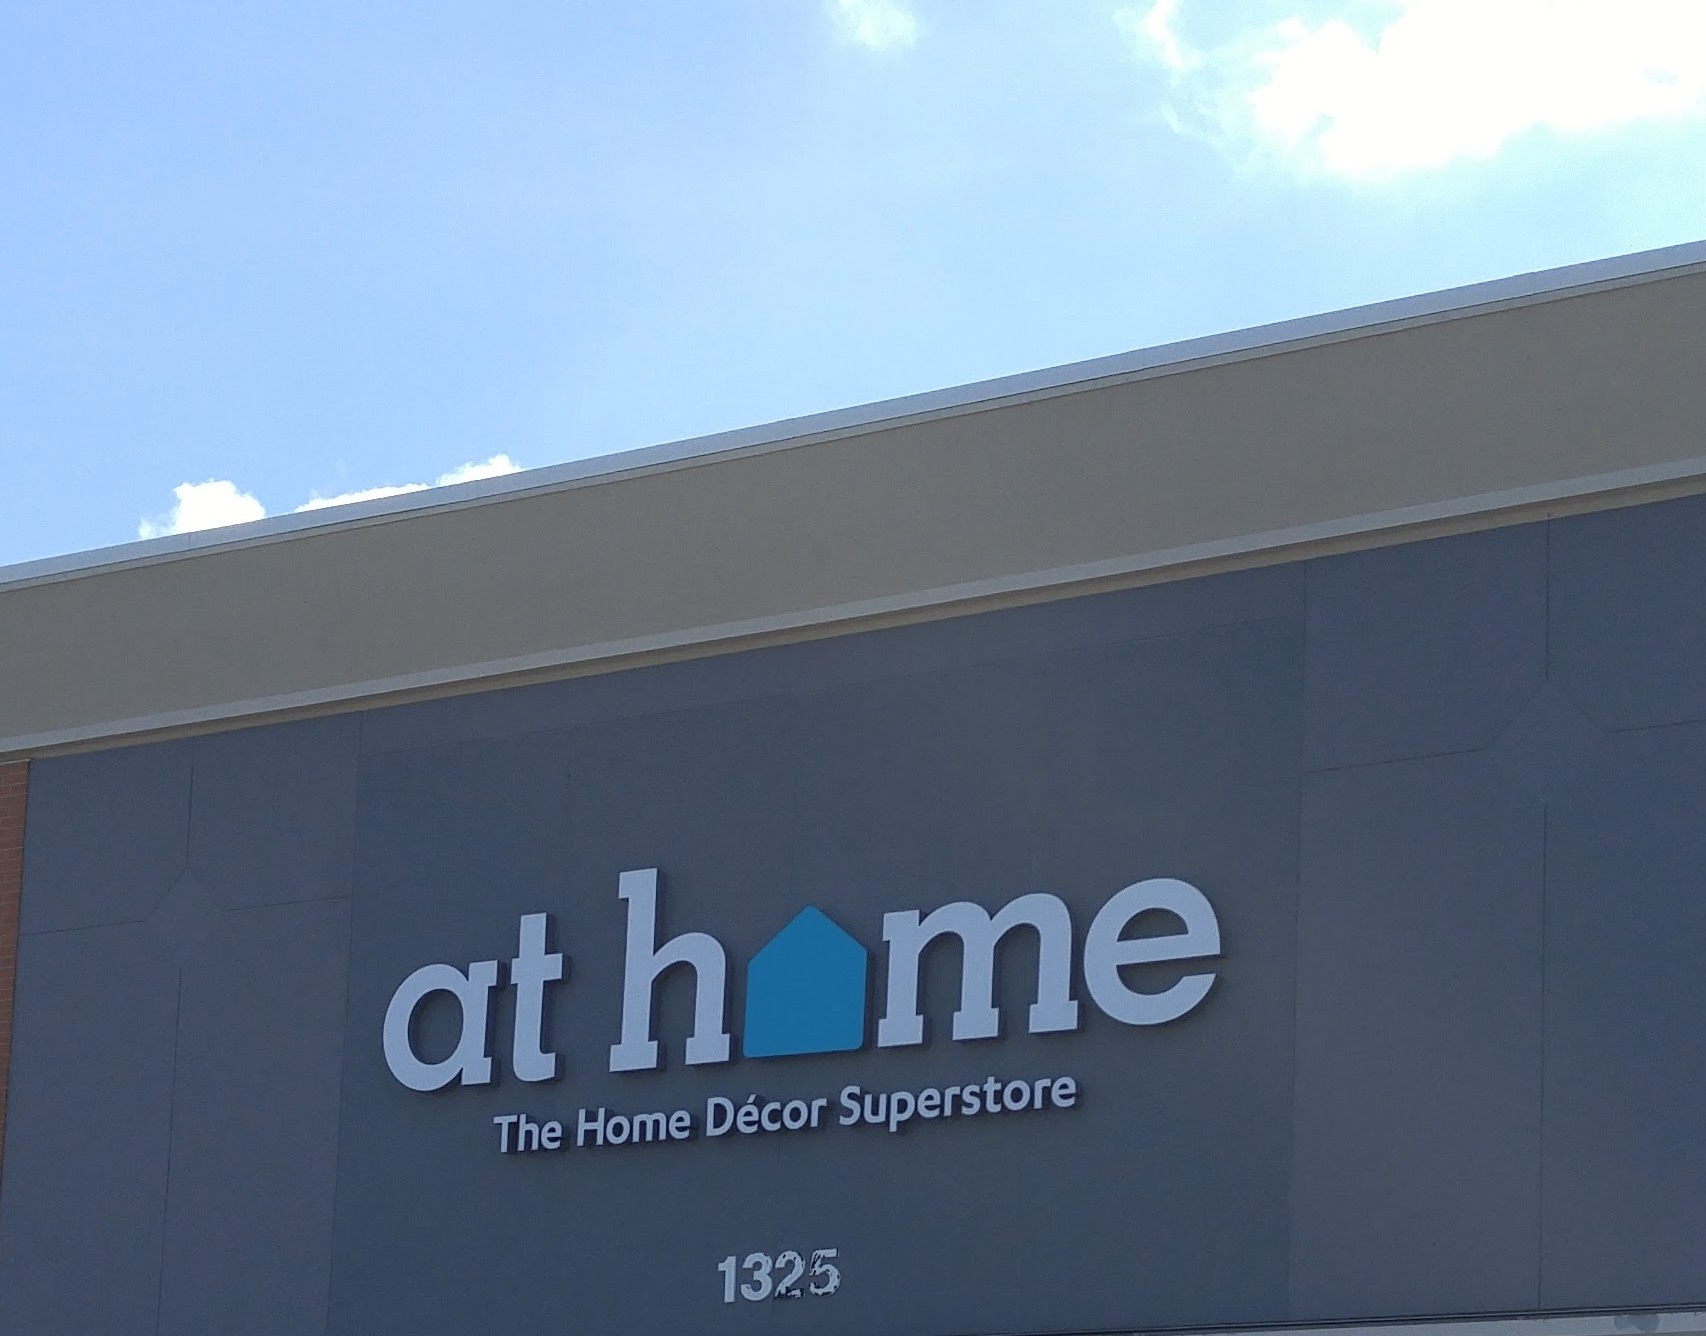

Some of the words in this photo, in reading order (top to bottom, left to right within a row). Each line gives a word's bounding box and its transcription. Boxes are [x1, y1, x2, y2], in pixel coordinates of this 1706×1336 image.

[383, 912, 563, 1091] at
[493, 1113, 562, 1153] The
[577, 1107, 691, 1147] Home
[706, 1094, 827, 1137] Décor
[839, 1076, 1076, 1132] Superstore
[718, 1248, 840, 1303] 1325
